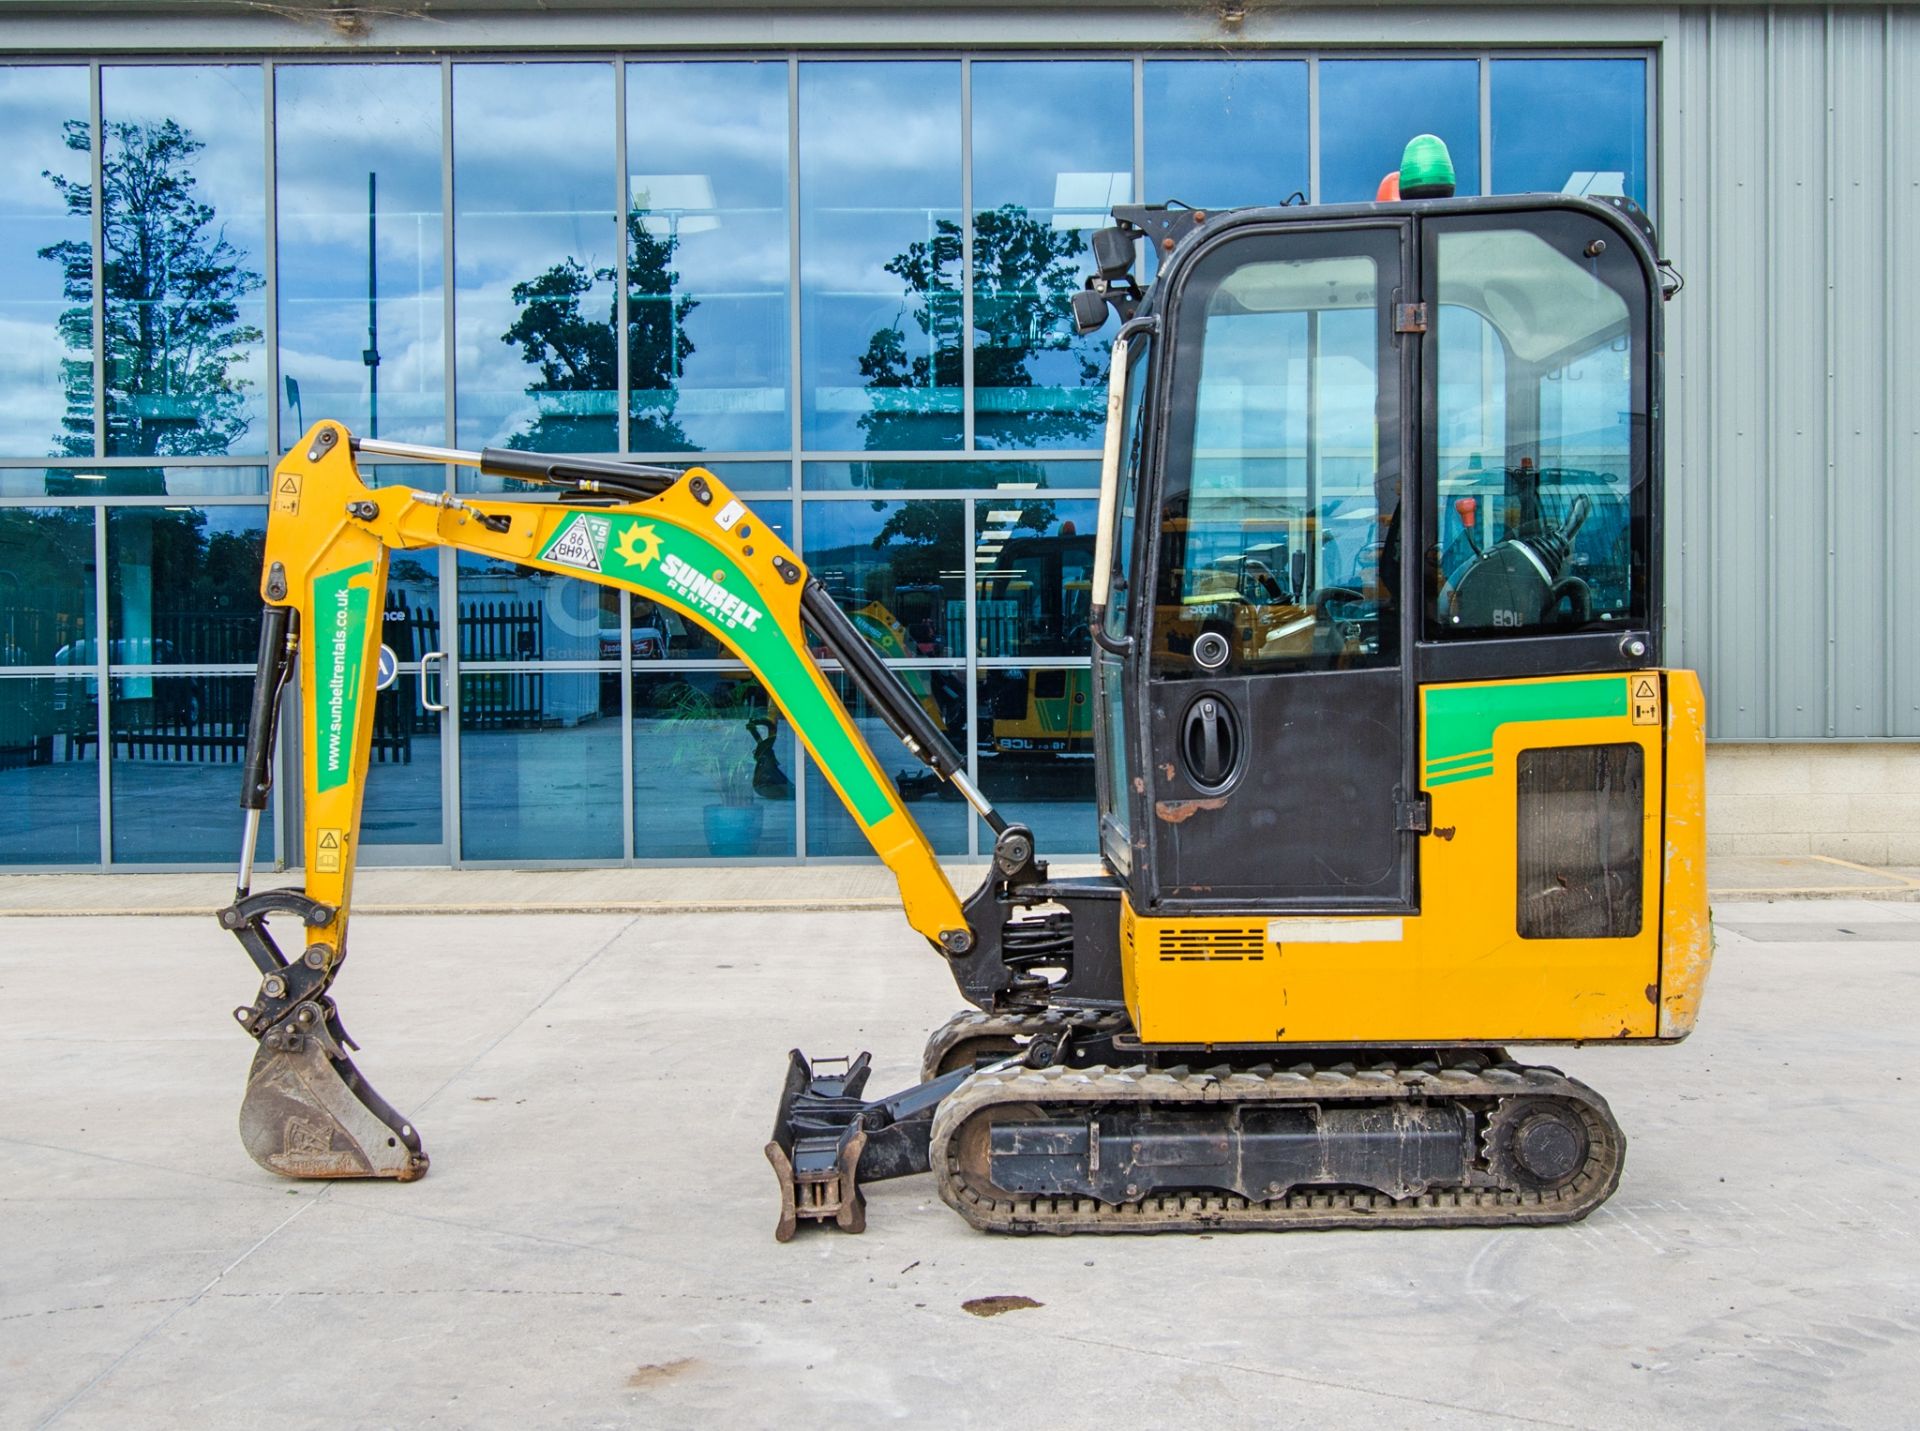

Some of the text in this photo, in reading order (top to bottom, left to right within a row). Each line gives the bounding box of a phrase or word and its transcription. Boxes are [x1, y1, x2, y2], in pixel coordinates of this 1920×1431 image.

[558, 543, 591, 561] BH9X
[569, 533, 584, 546] 86
[659, 553, 763, 629] SUNBELT
[666, 579, 739, 630] RENTALS
[327, 588, 350, 771] www.sunbeltrentals.co.uk
